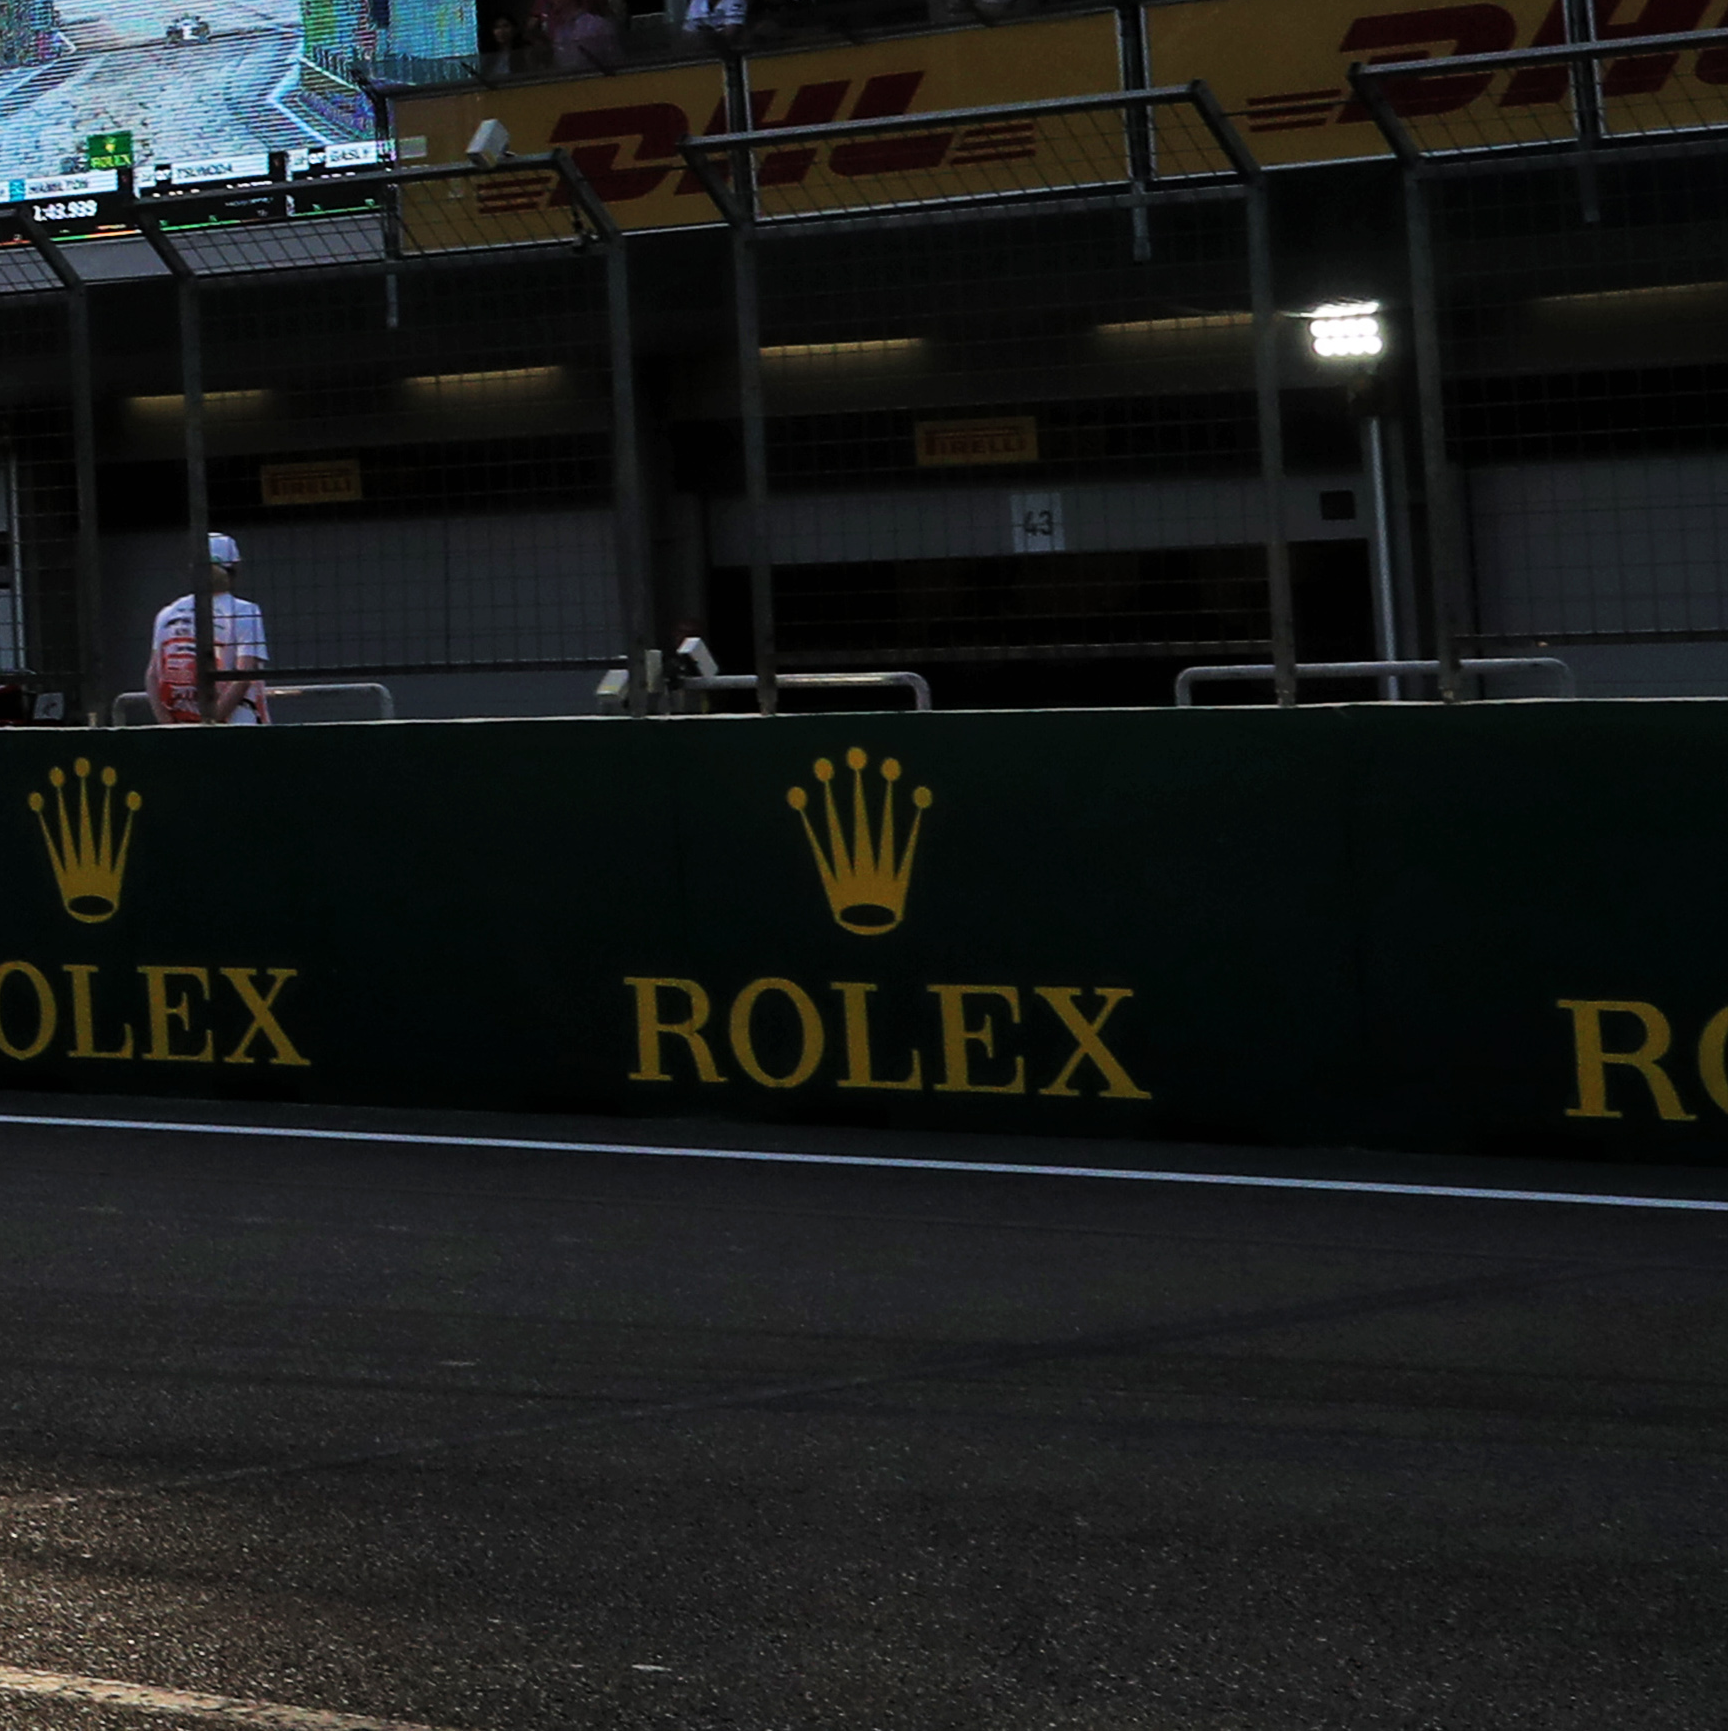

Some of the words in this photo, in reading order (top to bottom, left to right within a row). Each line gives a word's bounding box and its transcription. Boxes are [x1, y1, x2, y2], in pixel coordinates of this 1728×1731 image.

[550, 70, 954, 207] DHL
[925, 426, 1027, 456] PIRELLI
[269, 469, 351, 496] PIRELLI
[1023, 510, 1054, 536] 43
[623, 976, 1152, 1101] ROLEX
